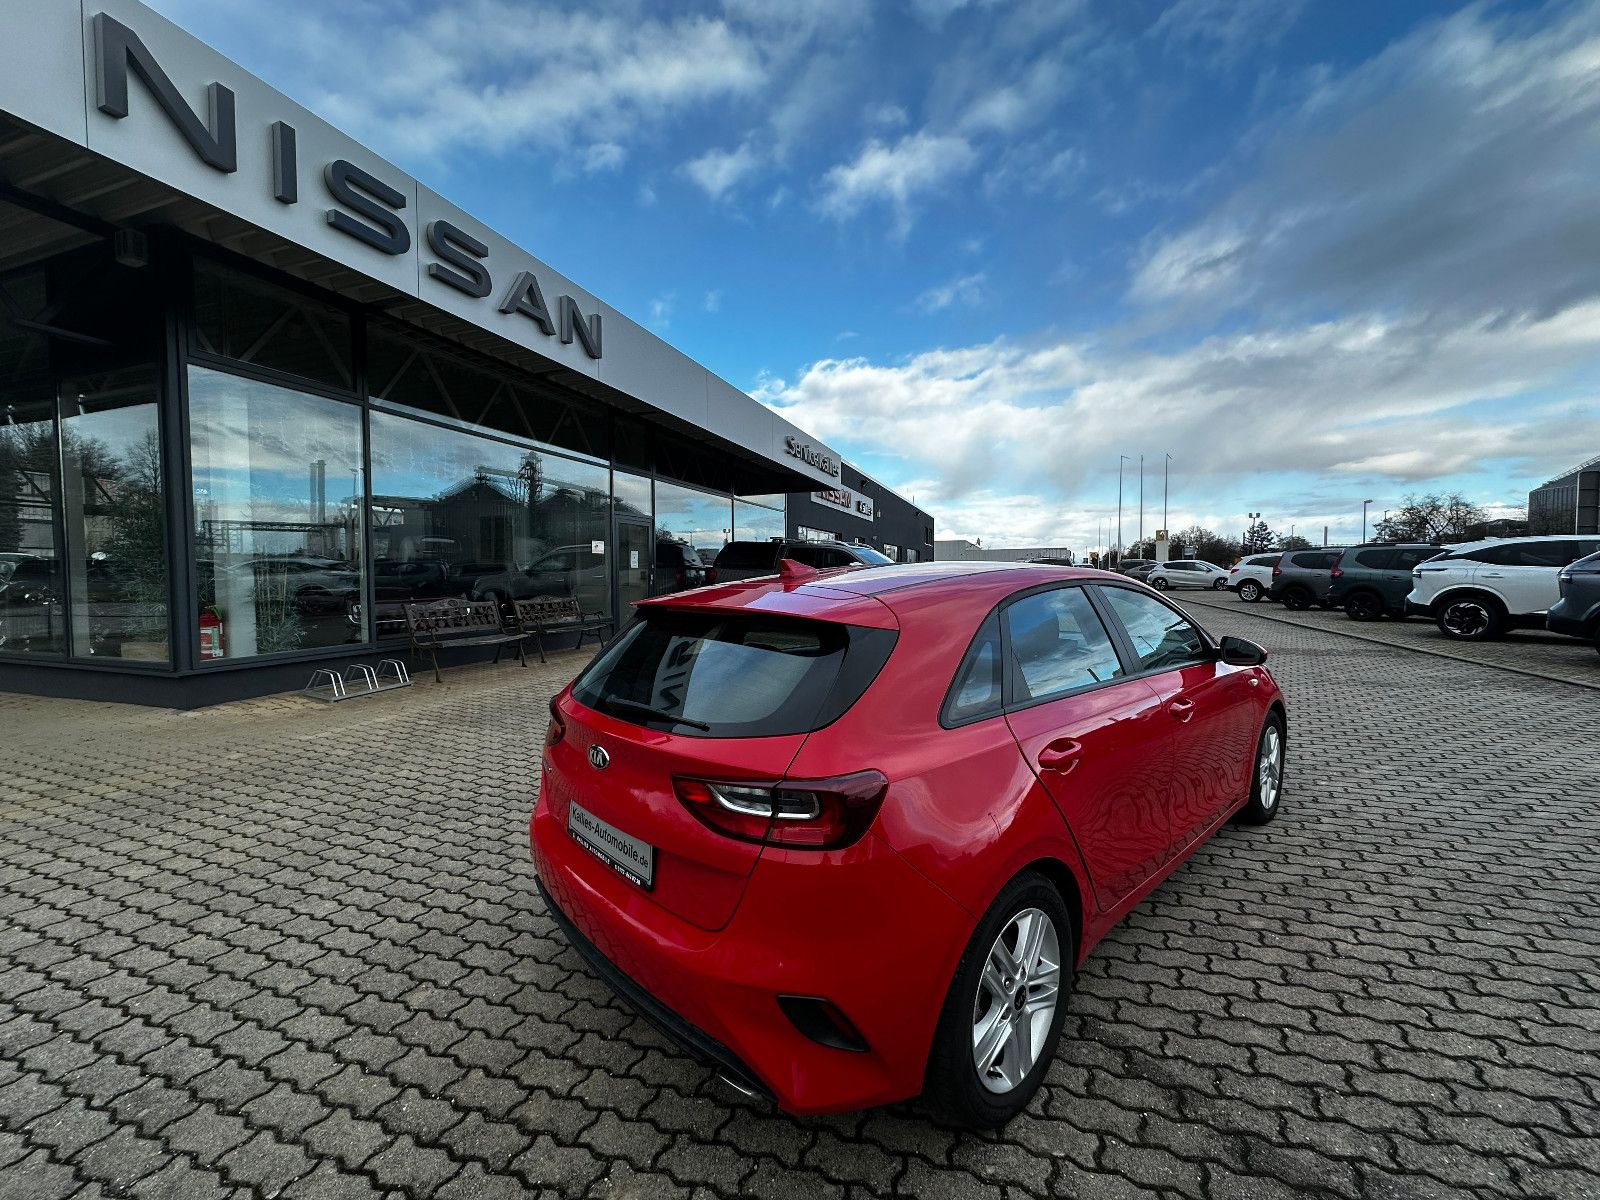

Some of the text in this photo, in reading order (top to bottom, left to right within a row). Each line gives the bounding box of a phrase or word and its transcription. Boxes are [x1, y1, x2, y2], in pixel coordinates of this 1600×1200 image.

[94, 12, 602, 360] NISSAN
[589, 747, 605, 767] KIA
[572, 805, 649, 868] Kallies-Automobile.de
